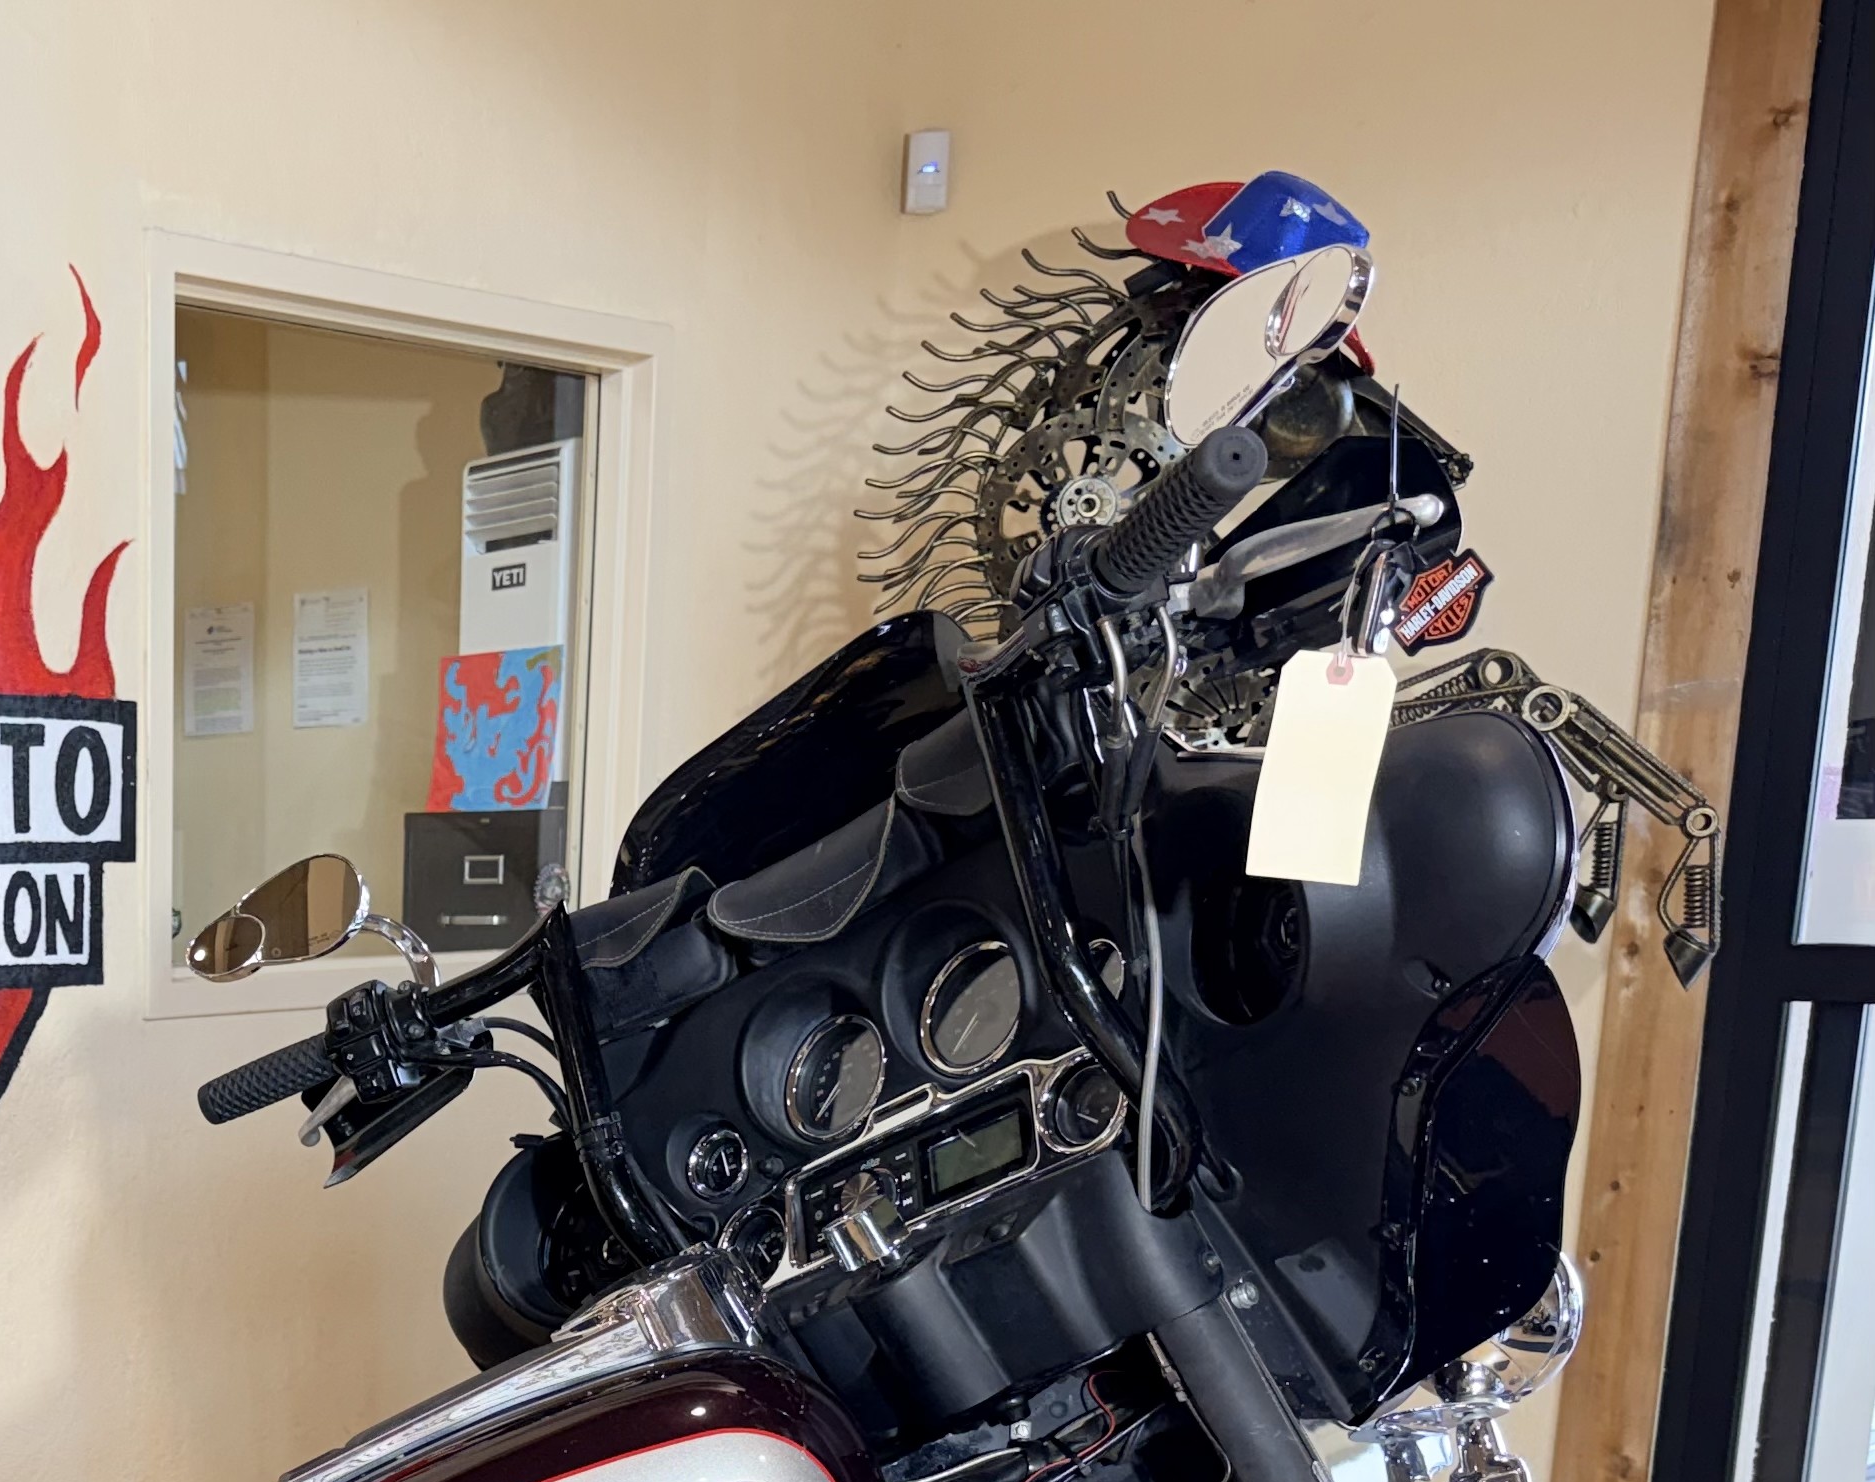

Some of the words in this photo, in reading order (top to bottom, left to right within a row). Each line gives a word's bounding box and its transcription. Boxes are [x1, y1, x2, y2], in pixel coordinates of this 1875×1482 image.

[493, 568, 524, 587] YETI
[1407, 568, 1449, 608] MOTOR
[1399, 563, 1478, 640] HARLEY-DAVIDSON
[1428, 595, 1469, 635] CYCLES
